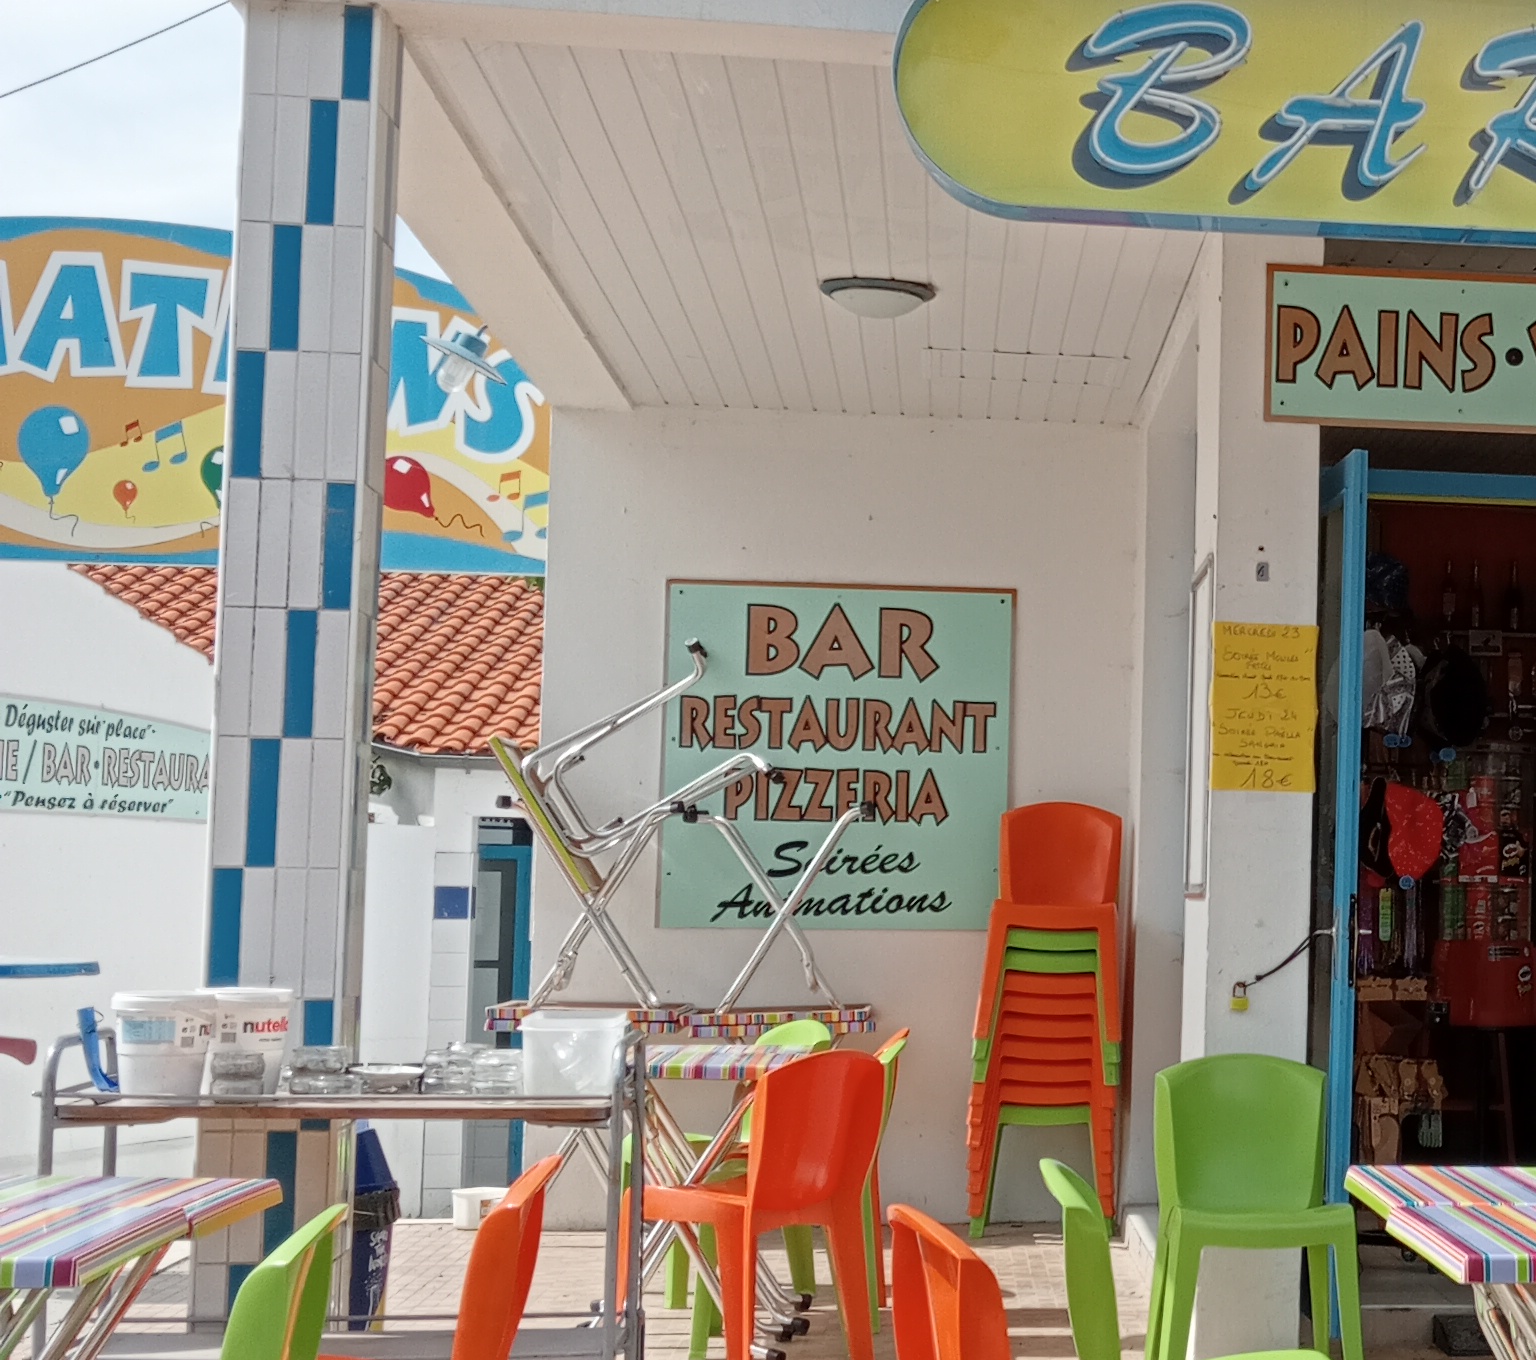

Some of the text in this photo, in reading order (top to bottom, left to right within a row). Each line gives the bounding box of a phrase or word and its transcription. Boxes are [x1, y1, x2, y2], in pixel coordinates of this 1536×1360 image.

[1275, 304, 1495, 393] PAINS
[745, 602, 941, 683] BAR
[4, 703, 75, 737] Déguster
[679, 695, 998, 755] RESTAURANT
[722, 767, 950, 827] PIZZERIA
[709, 883, 953, 923] Anmations
